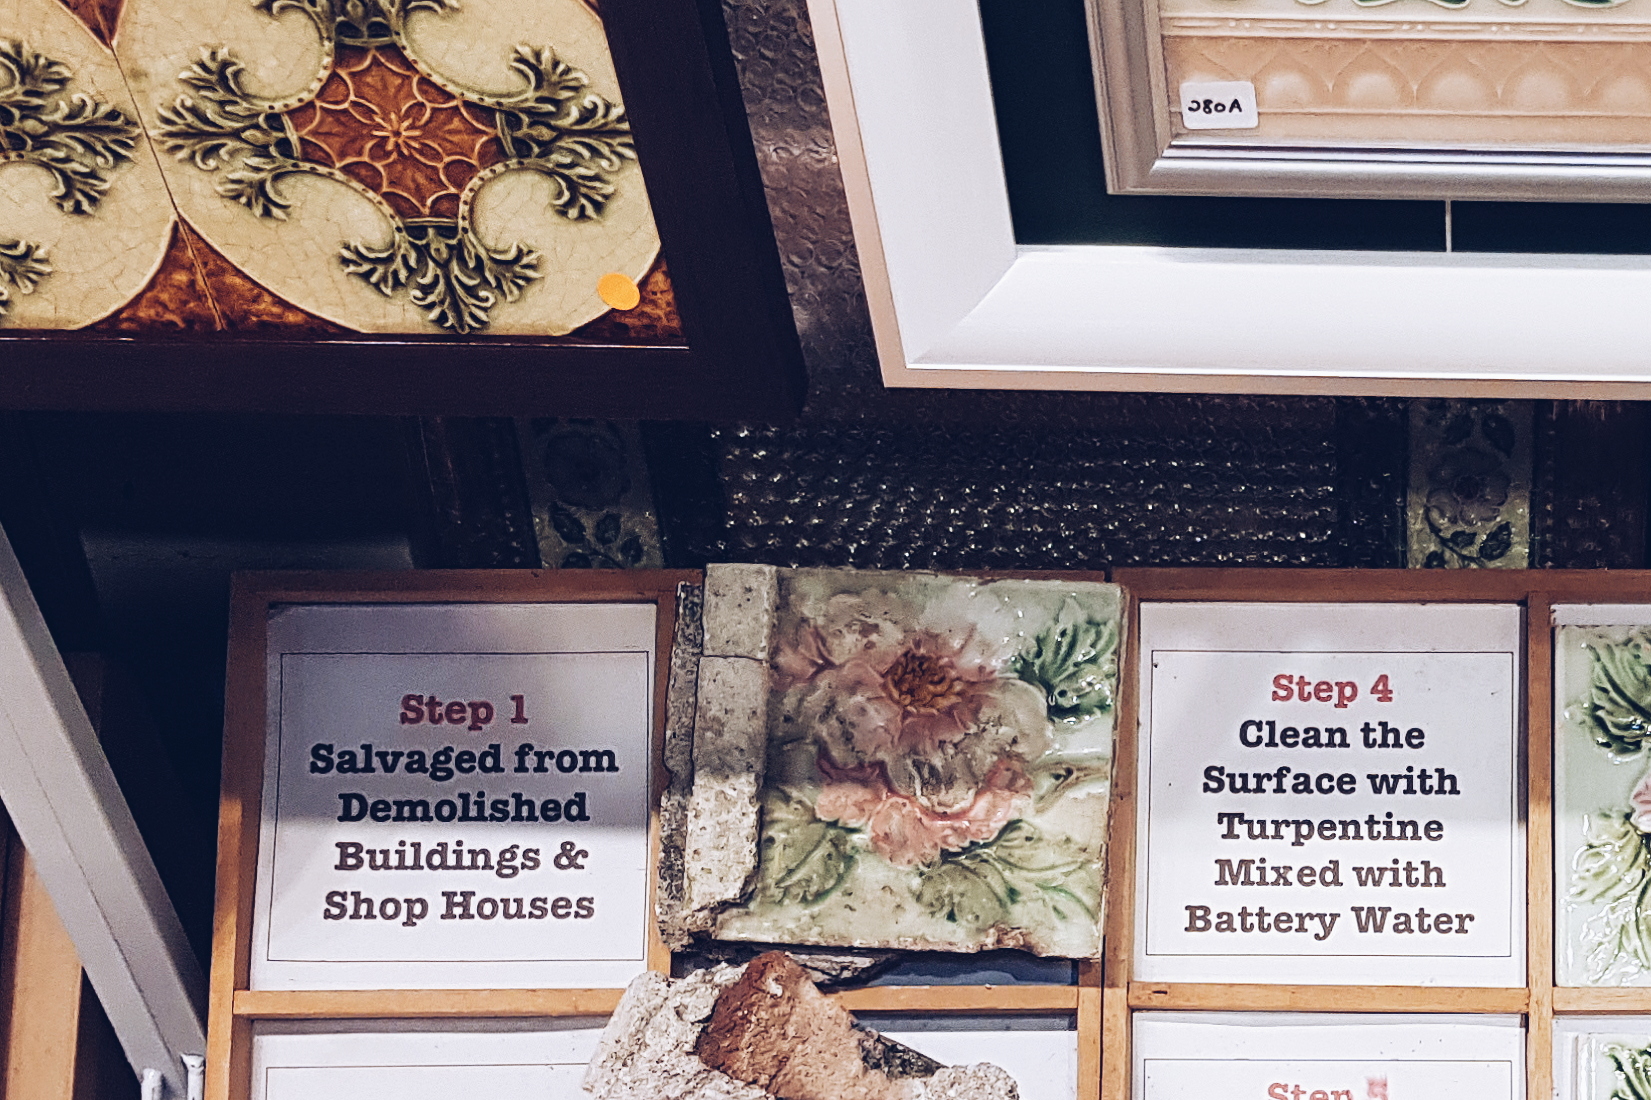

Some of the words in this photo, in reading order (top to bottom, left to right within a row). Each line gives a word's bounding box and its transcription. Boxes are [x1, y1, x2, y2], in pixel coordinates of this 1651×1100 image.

[1272, 674, 1358, 709] Step
[1370, 674, 1393, 703] 4
[400, 694, 495, 731] Step
[510, 694, 528, 725] 1
[1239, 720, 1350, 749] Clean
[1361, 721, 1425, 749] the
[310, 744, 505, 781] Salvaged
[514, 744, 619, 773] from
[1203, 766, 1357, 794] Surface
[1367, 766, 1460, 795] with
[337, 792, 590, 822] Demolished
[1218, 812, 1443, 846] Turpentine
[334, 840, 541, 878] Buildings
[553, 841, 589, 870] &
[1215, 858, 1343, 887] Mixed
[1353, 859, 1446, 888] with
[323, 891, 428, 927] Shop
[440, 891, 594, 920] Houses
[1185, 905, 1341, 941] Battery
[1351, 906, 1474, 934] Water
